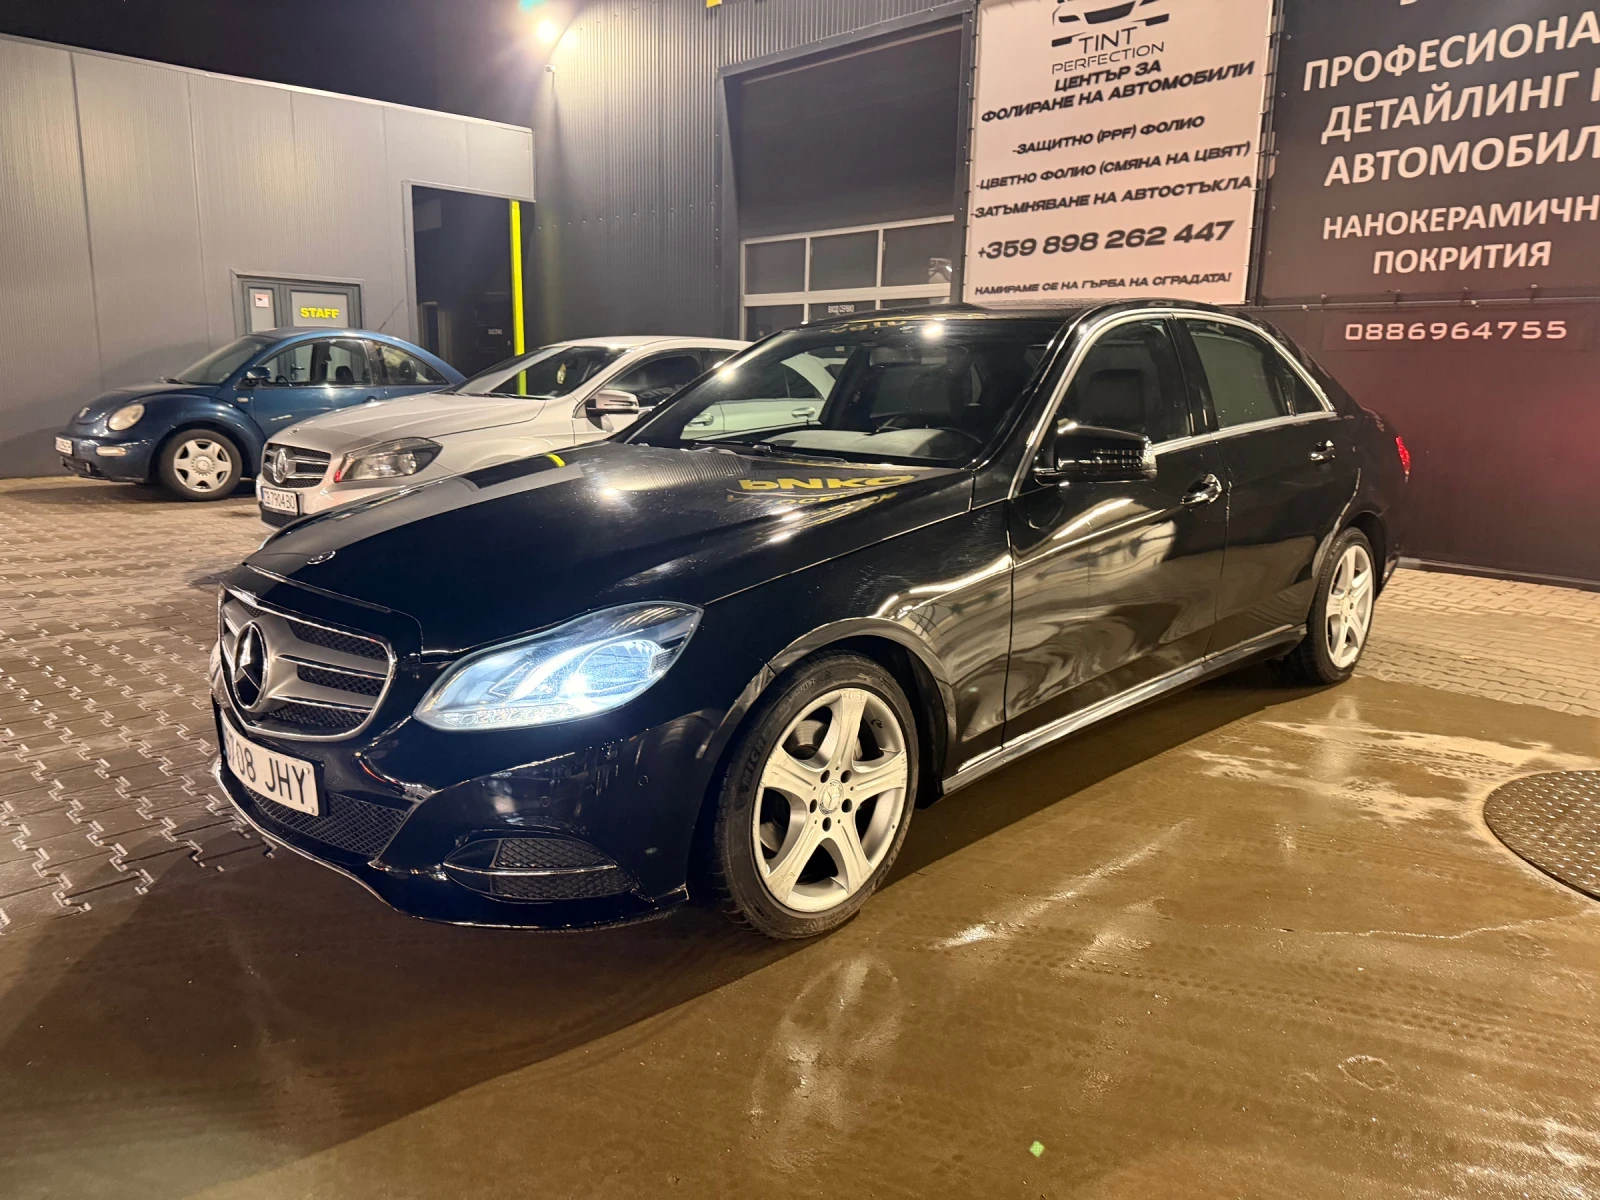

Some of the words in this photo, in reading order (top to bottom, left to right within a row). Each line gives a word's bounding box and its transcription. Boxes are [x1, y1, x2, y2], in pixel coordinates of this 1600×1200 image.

[1051, 41, 1165, 75] PERFECTION
[1078, 26, 1138, 54] TINT
[981, 96, 1074, 123] ФОЛИРАНЕ
[1078, 90, 1103, 105] НА
[1108, 60, 1256, 101] АВТОМОБИЛИ
[1054, 65, 1131, 92] ЦЕНТЪР
[1134, 60, 1162, 77] ЗА
[1320, 70, 1580, 145] ДЕТАЙЛИНГ
[1012, 133, 1094, 155] -ЗАЩИТНО
[1096, 124, 1137, 145] (PPF)
[1140, 115, 1206, 136] ФОЛИО
[976, 172, 1037, 190] -ЦВЕТНО
[1040, 164, 1096, 182] ФОЛИО
[1099, 154, 1162, 176] (СМЯНА
[1165, 151, 1191, 164] НА
[1193, 140, 1251, 163] ЦВЯТ)
[970, 194, 1091, 219] -ЗАТЪМНЯВАНЕ
[1093, 191, 1118, 205] НА
[1120, 175, 1253, 202] АВТОСТЪКЛА
[977, 237, 1037, 260] +359
[1042, 232, 1099, 255] 898
[1104, 226, 1167, 250] 262
[1173, 220, 1236, 244] 447
[1373, 241, 1552, 275] ПОКРИТИЯ
[975, 283, 1040, 296] НАМИРАМЕ
[1042, 281, 1059, 292] СЕ
[1061, 280, 1079, 291] НА
[1082, 277, 1126, 289] ГЪРБА
[1128, 277, 1149, 287] НА
[1152, 272, 1232, 287] СГРАДАТА!
[300, 307, 340, 319] STAFF
[1345, 320, 1568, 341] 0886964755
[265, 757, 306, 805] JHY
